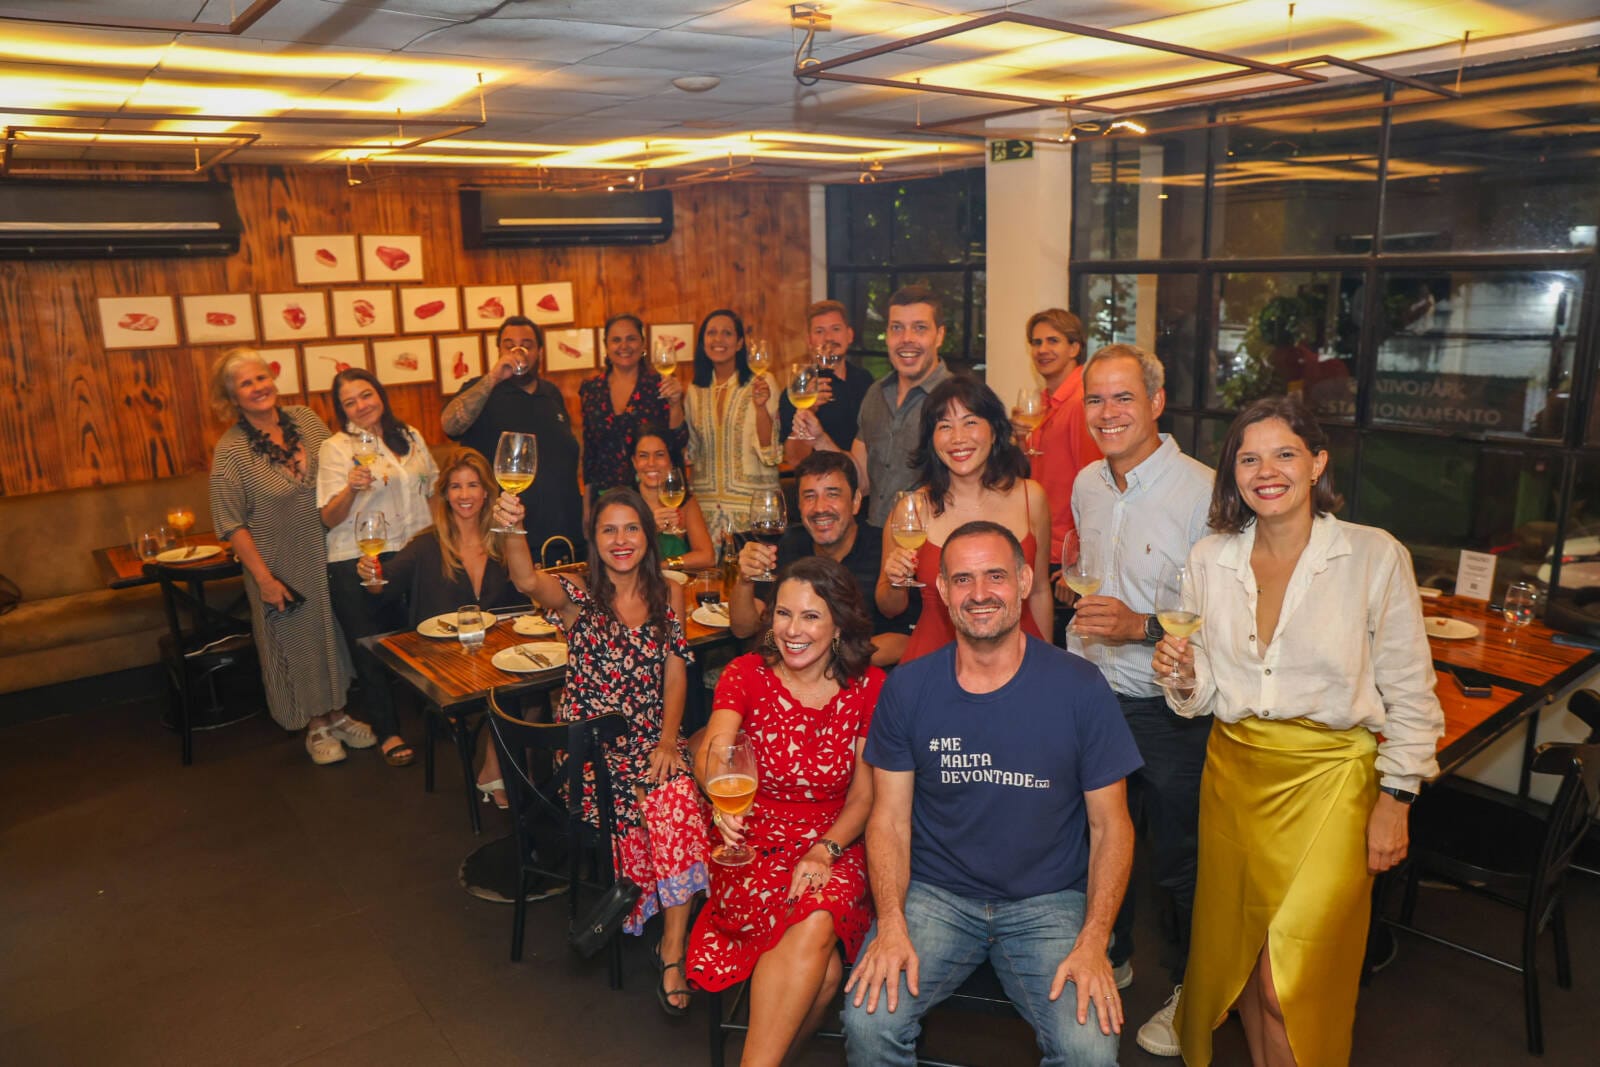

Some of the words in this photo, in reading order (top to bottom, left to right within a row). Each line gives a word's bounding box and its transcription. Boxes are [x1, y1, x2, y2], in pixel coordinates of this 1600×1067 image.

[929, 737, 962, 752] #ME
[940, 753, 992, 768] MALTA
[941, 769, 1034, 788] DEVONTADE
